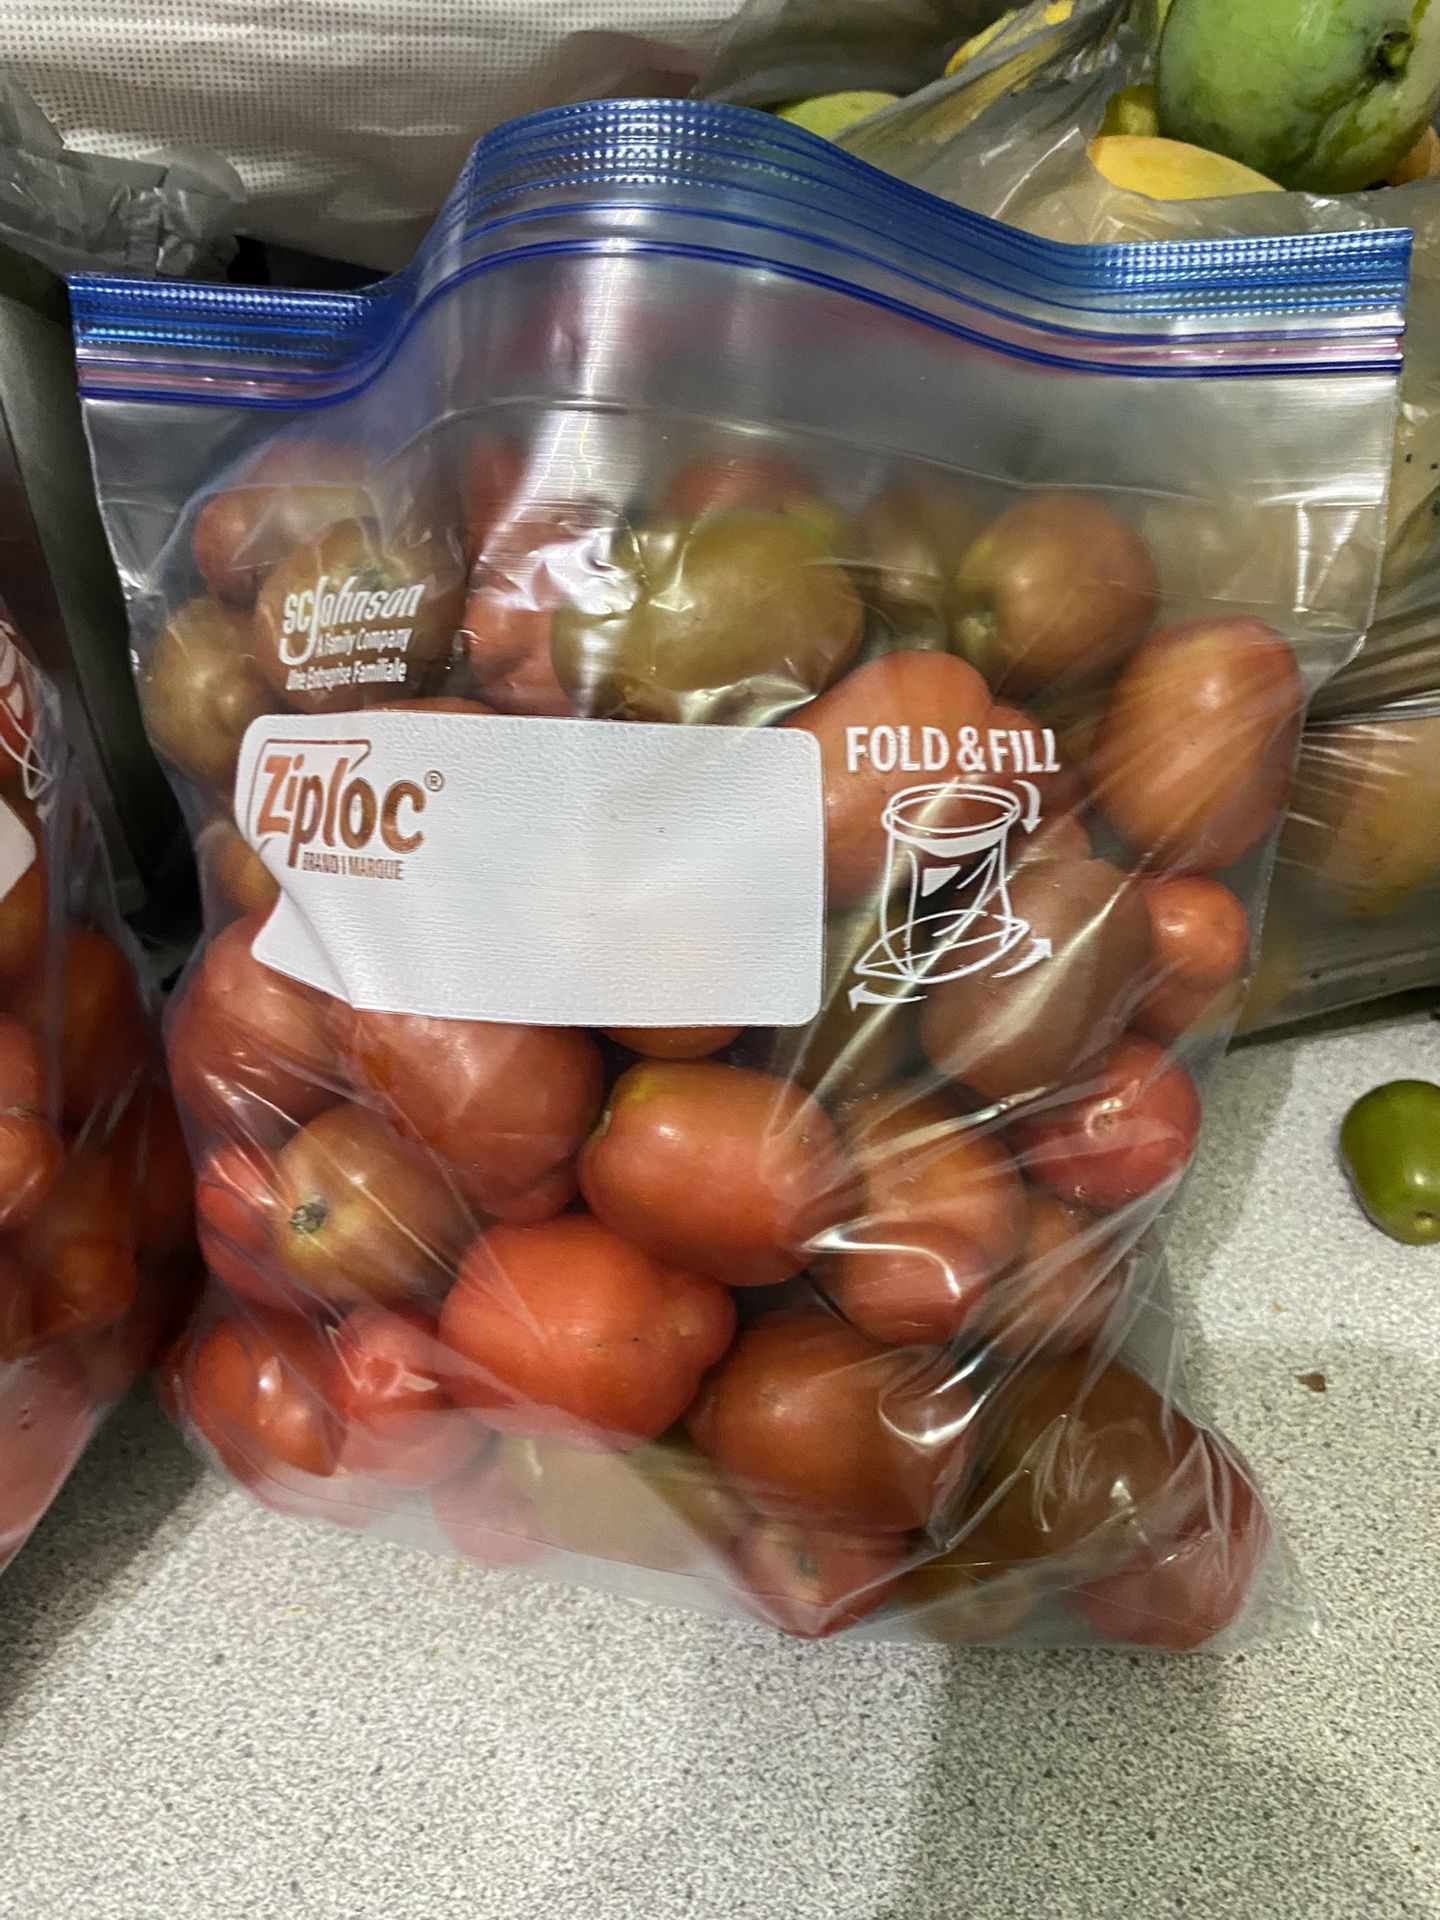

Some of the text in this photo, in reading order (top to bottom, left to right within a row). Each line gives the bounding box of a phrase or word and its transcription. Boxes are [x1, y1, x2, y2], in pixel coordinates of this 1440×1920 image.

[324, 629, 356, 656] Family
[356, 627, 413, 653] Company
[352, 657, 408, 684] Familiale
[845, 725, 1062, 774] FOLD & FILL
[303, 851, 340, 874] BRAND
[348, 855, 405, 881] MARQUE
